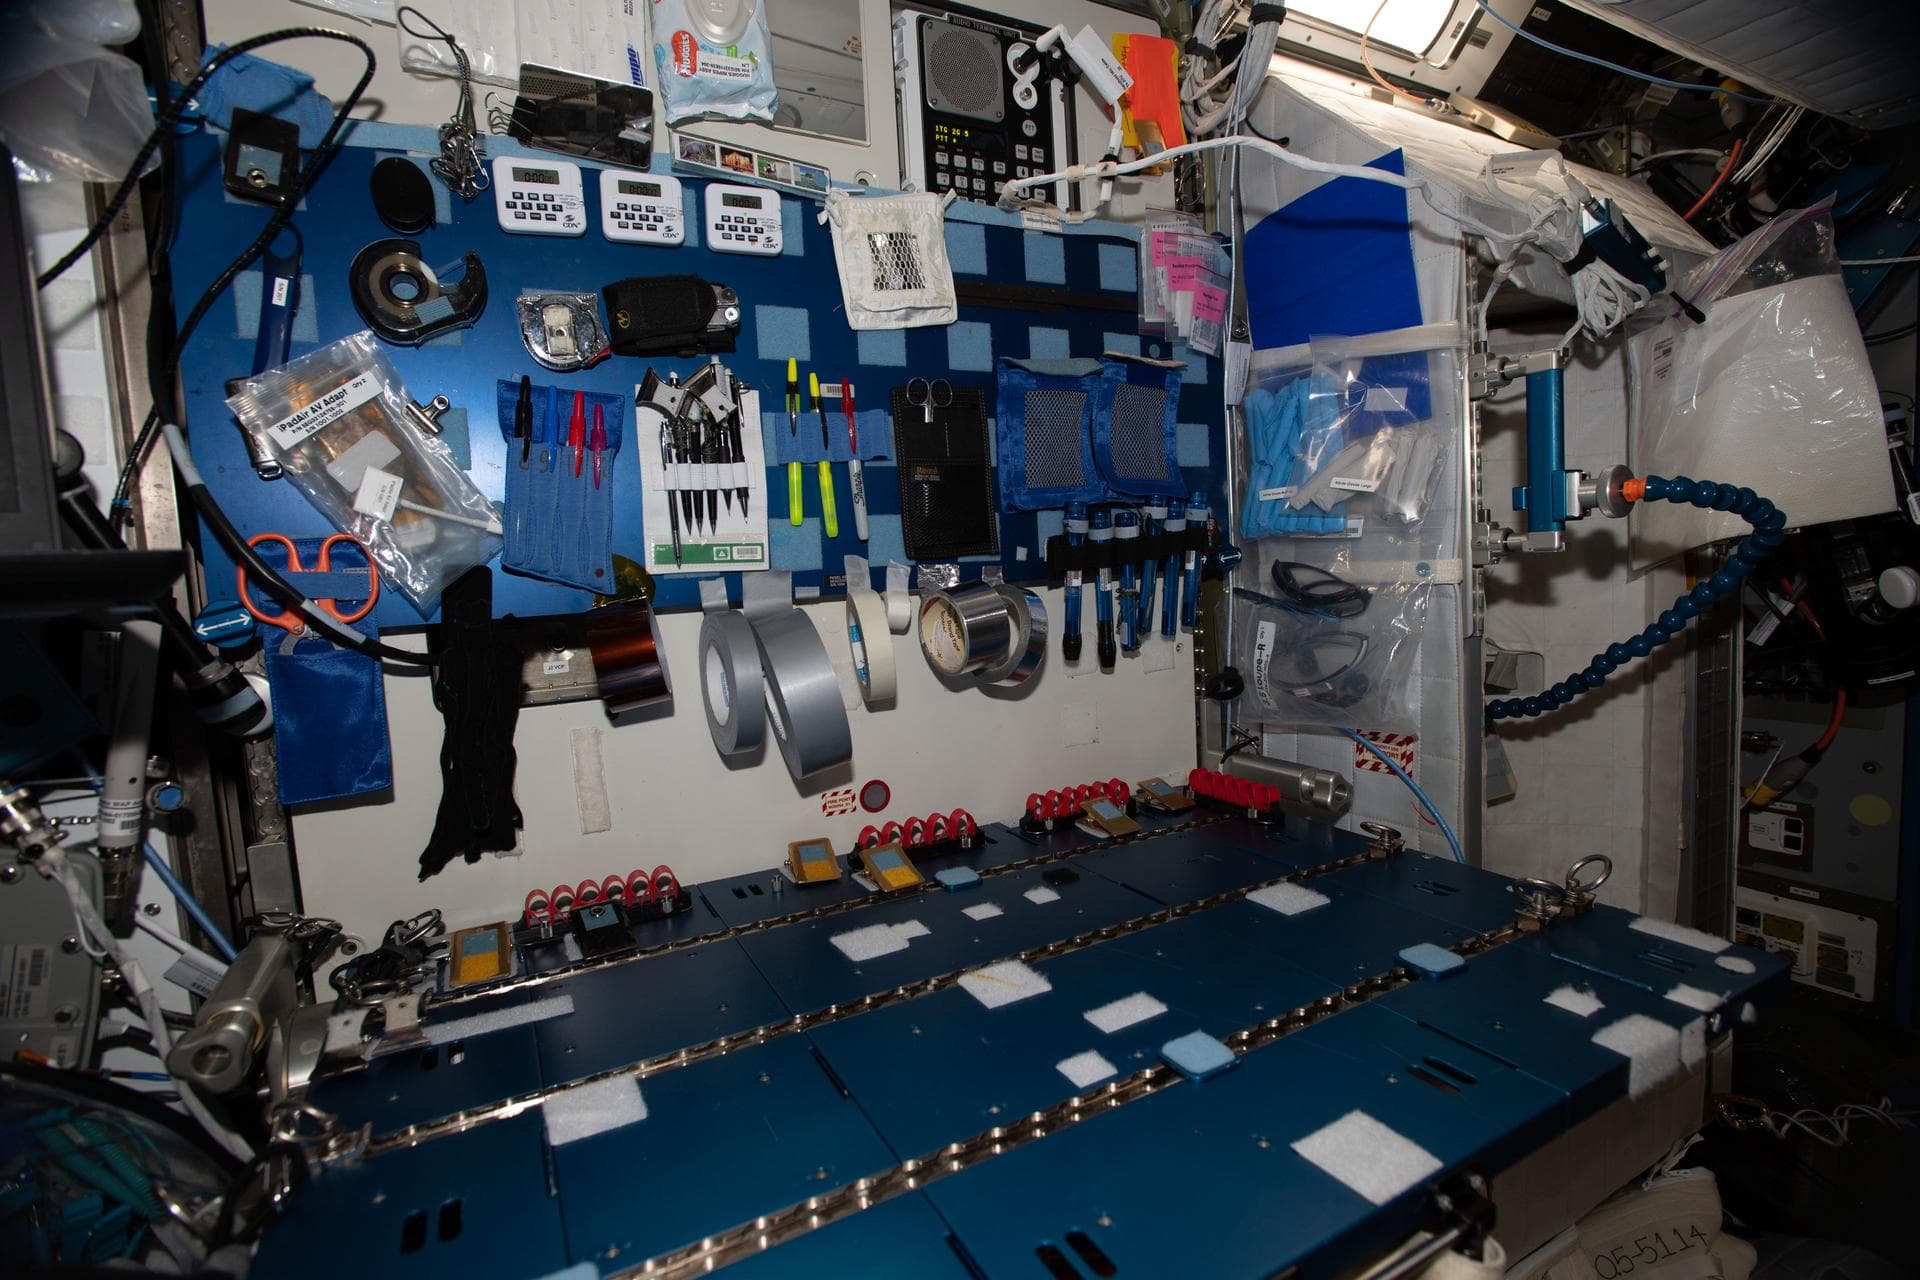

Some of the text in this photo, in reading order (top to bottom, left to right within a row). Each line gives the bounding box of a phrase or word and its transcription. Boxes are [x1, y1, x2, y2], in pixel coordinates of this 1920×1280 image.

[952, 17, 970, 28] AUDIO
[680, 33, 691, 72] HUGGIES
[278, 410, 311, 433] iPadAir
[311, 402, 323, 414] AV
[322, 388, 348, 406] Adapt
